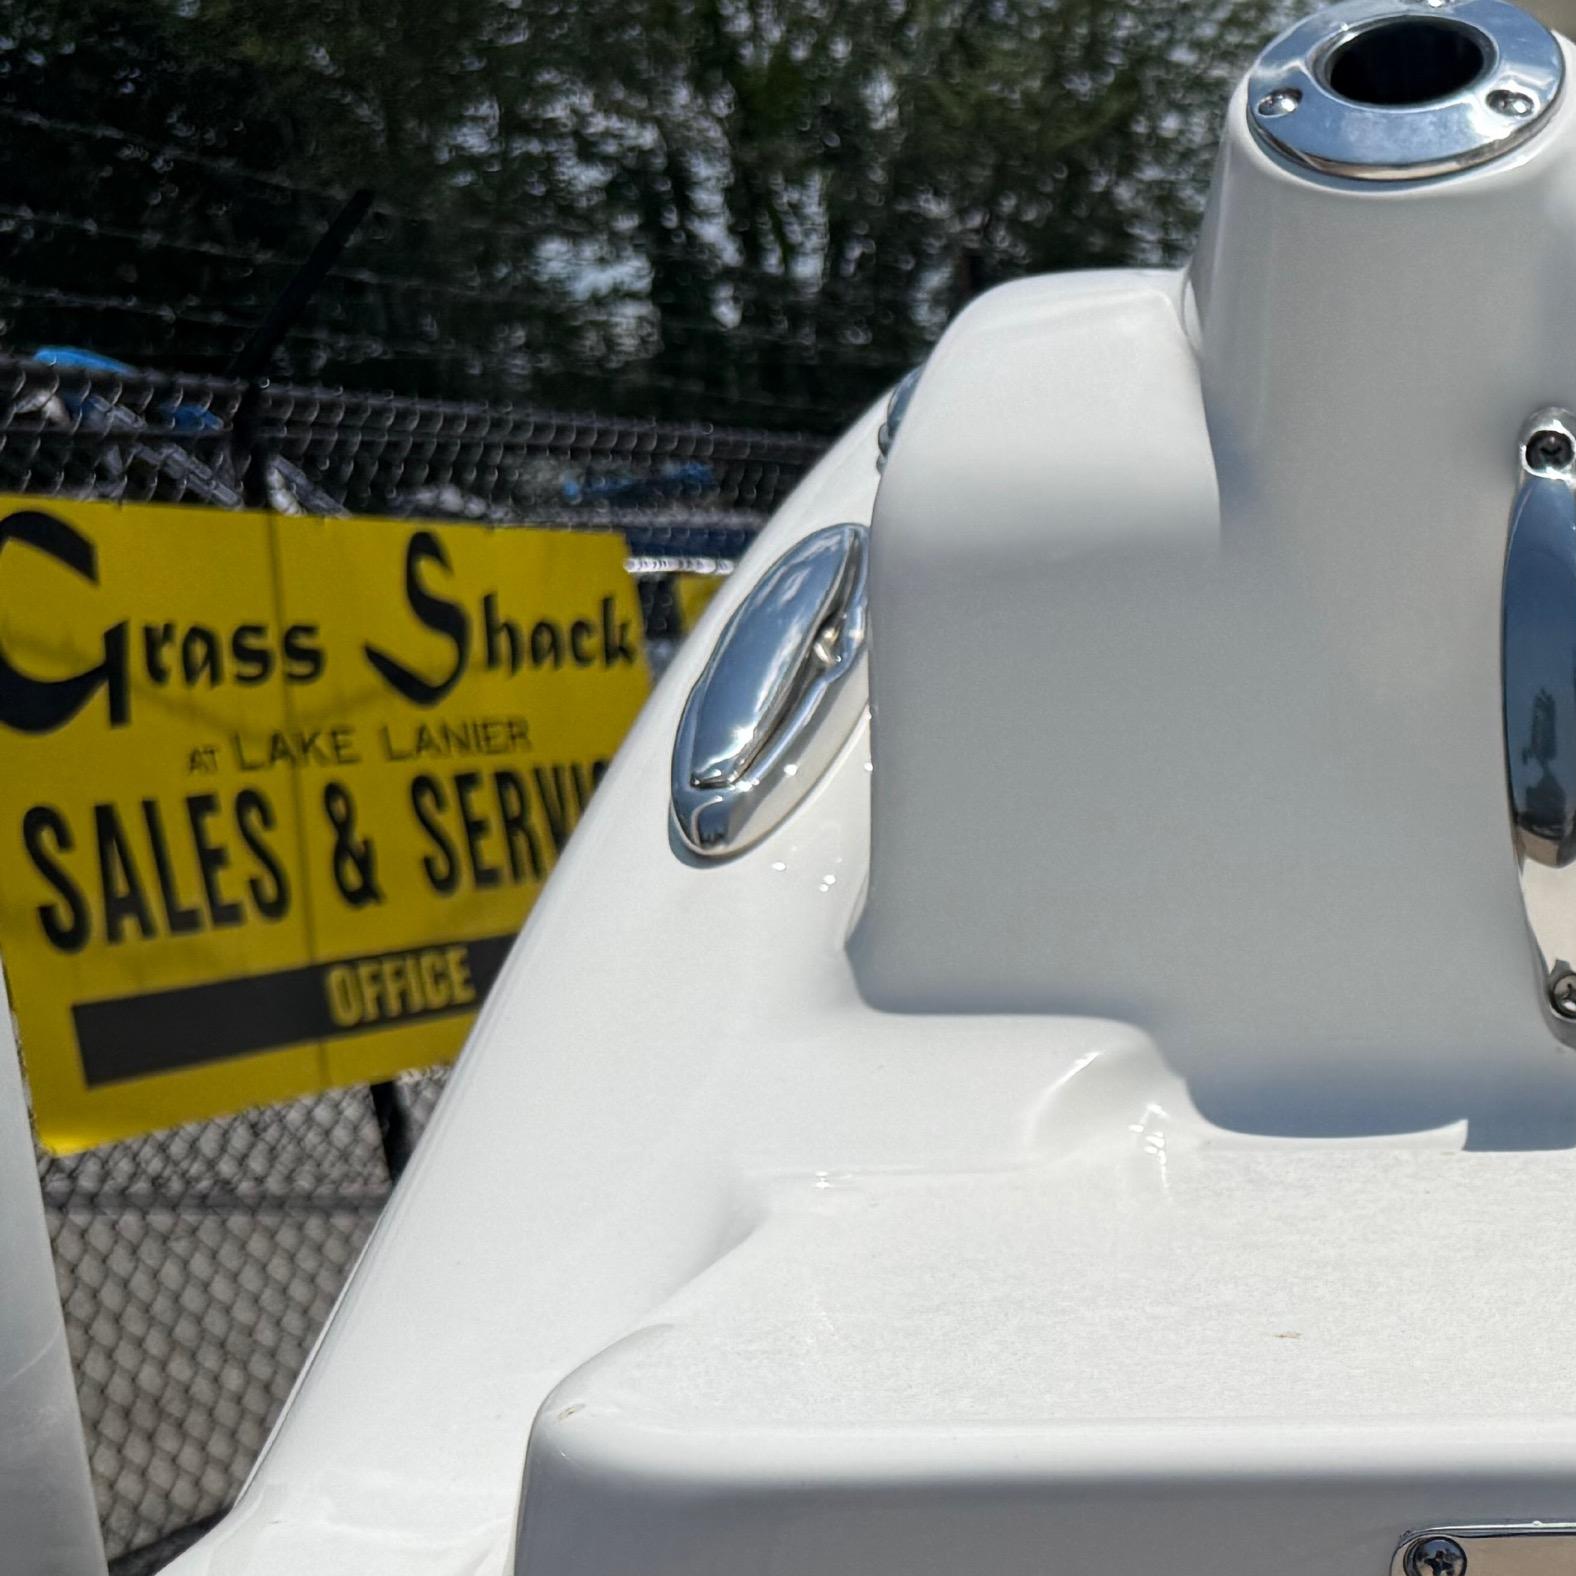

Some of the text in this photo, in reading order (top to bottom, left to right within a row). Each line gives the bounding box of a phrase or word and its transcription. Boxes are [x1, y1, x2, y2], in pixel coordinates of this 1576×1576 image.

[0, 510, 638, 734] Grass Shack
[186, 717, 531, 774] AT LAKE LANIER
[22, 759, 609, 953] SALES & SERV
[326, 945, 475, 1028] OFFICE
